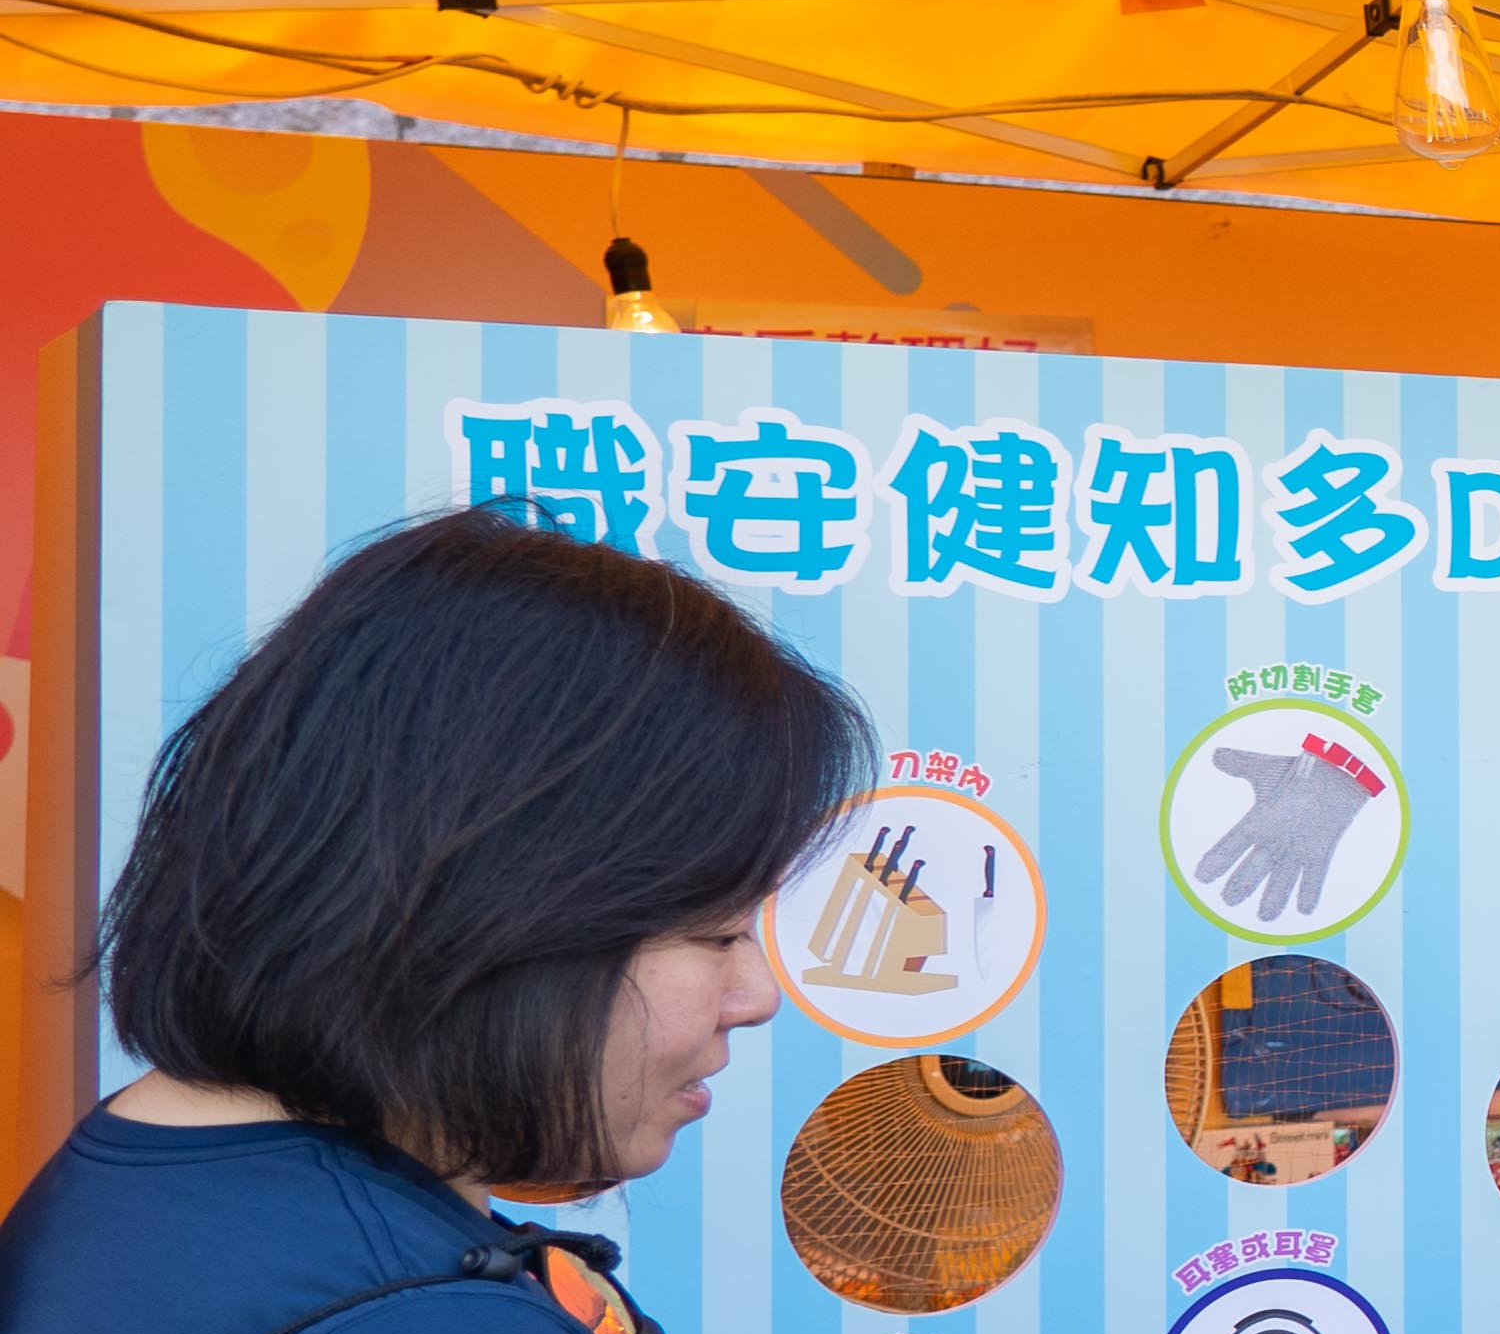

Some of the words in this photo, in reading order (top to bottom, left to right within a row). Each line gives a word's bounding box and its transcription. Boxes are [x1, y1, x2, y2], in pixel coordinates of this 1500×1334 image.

[1226, 664, 1384, 715] 防切割手套
[888, 750, 993, 797] 刀架內
[1174, 1230, 1338, 1294] 耳塞或耳罩
